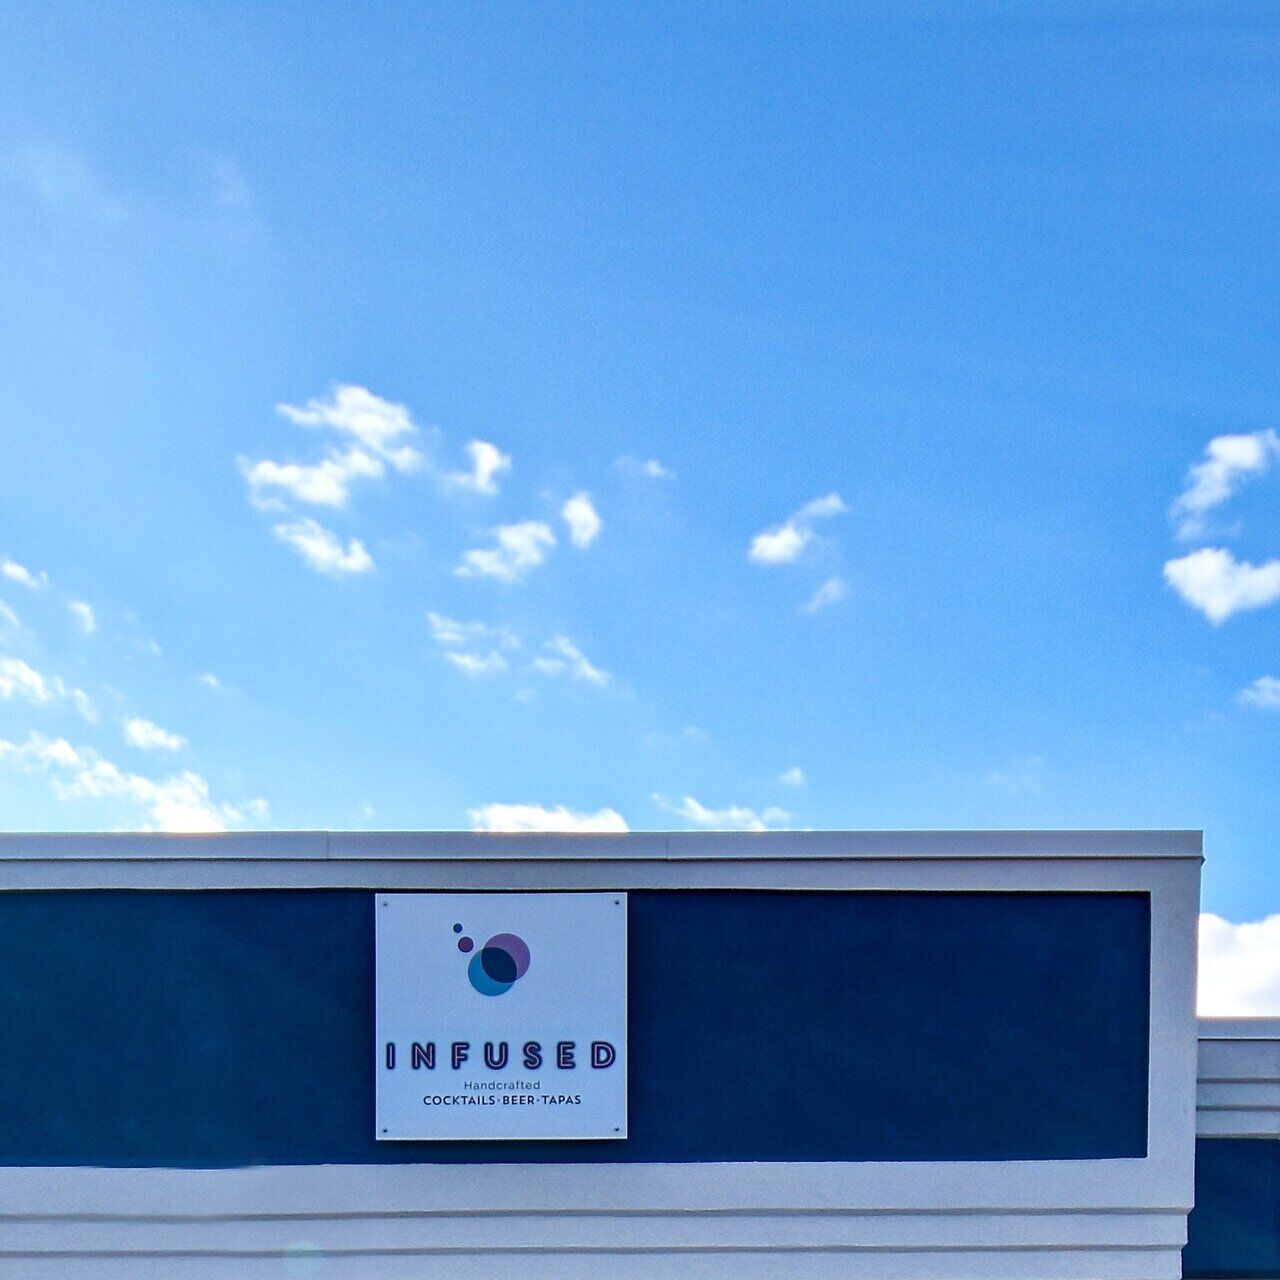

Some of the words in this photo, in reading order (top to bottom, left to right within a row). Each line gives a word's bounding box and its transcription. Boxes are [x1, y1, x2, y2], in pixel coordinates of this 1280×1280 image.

[385, 1041, 617, 1070] INFUSED
[463, 1081, 541, 1091] Handcrafted
[423, 1095, 496, 1106] COCKTAILS
[502, 1095, 535, 1106] BEER
[541, 1094, 582, 1105] TAPAS
